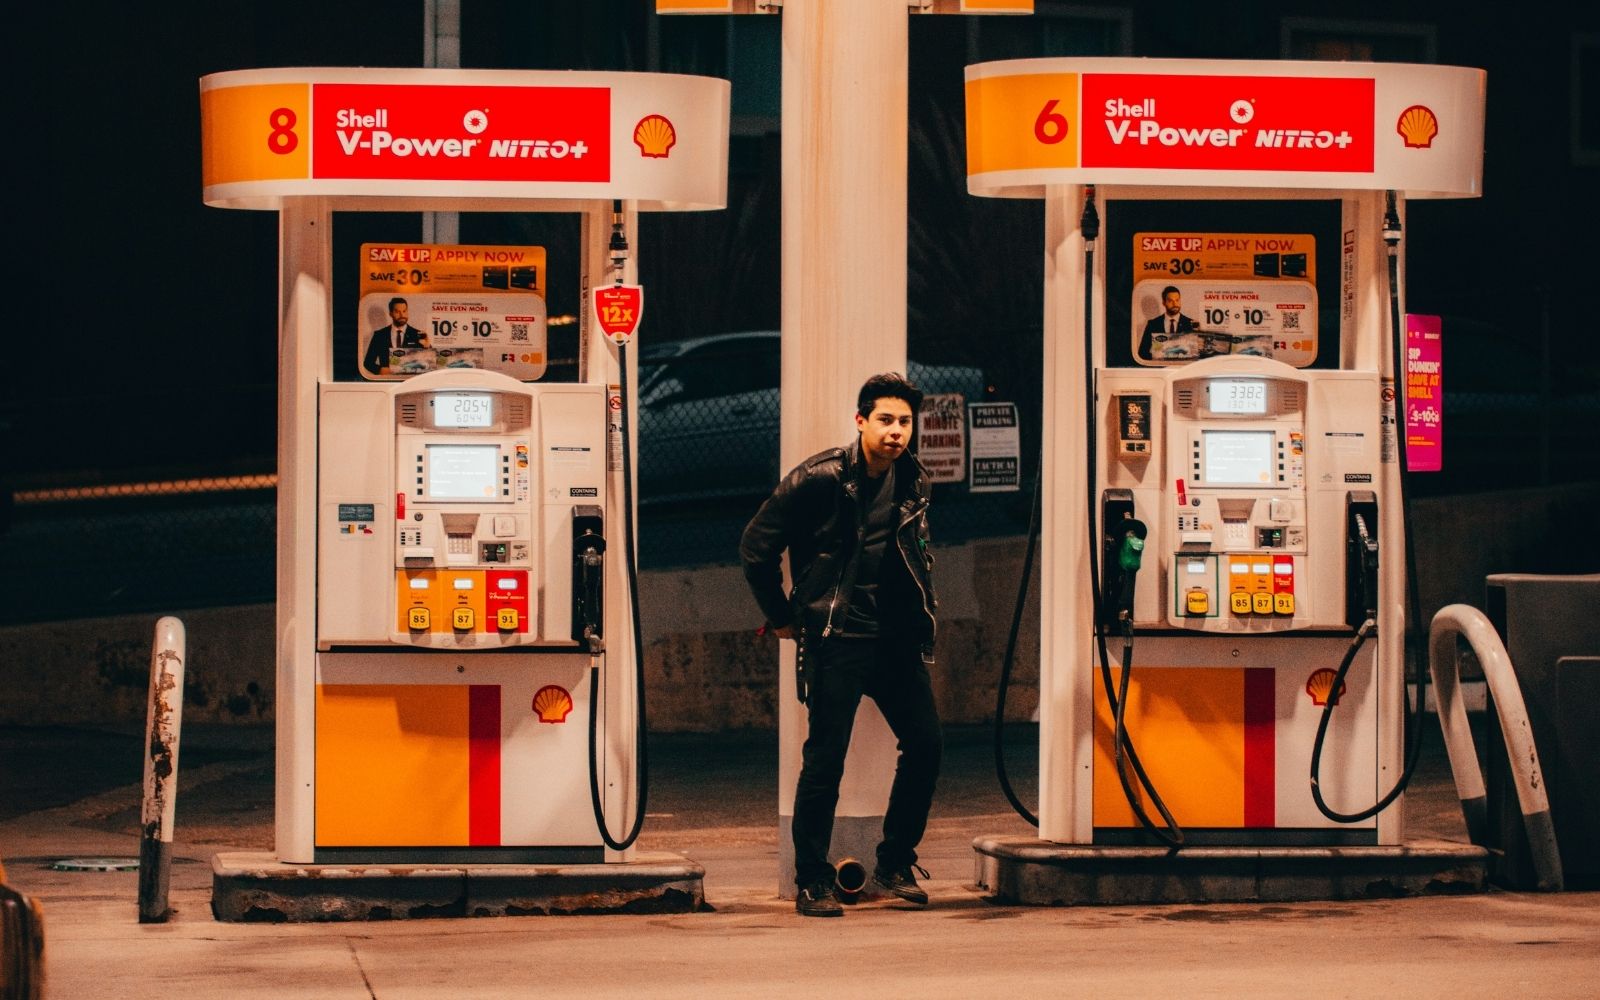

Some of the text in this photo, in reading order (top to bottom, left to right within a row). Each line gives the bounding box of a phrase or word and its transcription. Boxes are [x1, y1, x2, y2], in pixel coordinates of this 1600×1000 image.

[1105, 98, 1155, 118] Shell
[336, 108, 387, 128] Shell
[1034, 99, 1068, 144] 6
[267, 107, 298, 155] 8
[1105, 121, 1243, 148] V-Power
[336, 131, 477, 158] V-Power
[1142, 238, 1177, 251] SAVE
[1206, 239, 1250, 251] APPLY
[1255, 240, 1294, 251] NOW
[370, 248, 405, 262] SAVE
[435, 250, 479, 262] APPLY
[484, 251, 525, 263] NOW
[1143, 261, 1168, 271] SAVE
[370, 272, 395, 281] SAVE
[468, 305, 488, 313] MORE
[602, 305, 633, 323] 12x
[1408, 347, 1421, 360] SIP
[977, 407, 1010, 416] PRIVATE
[976, 417, 1012, 426] PARKING
[921, 434, 961, 449] PARKING
[1235, 599, 1248, 607] 85
[1257, 599, 1269, 607] 87
[1278, 599, 1290, 607] 91
[413, 615, 425, 623] 85
[457, 615, 470, 623] 87
[501, 615, 514, 624] 91
